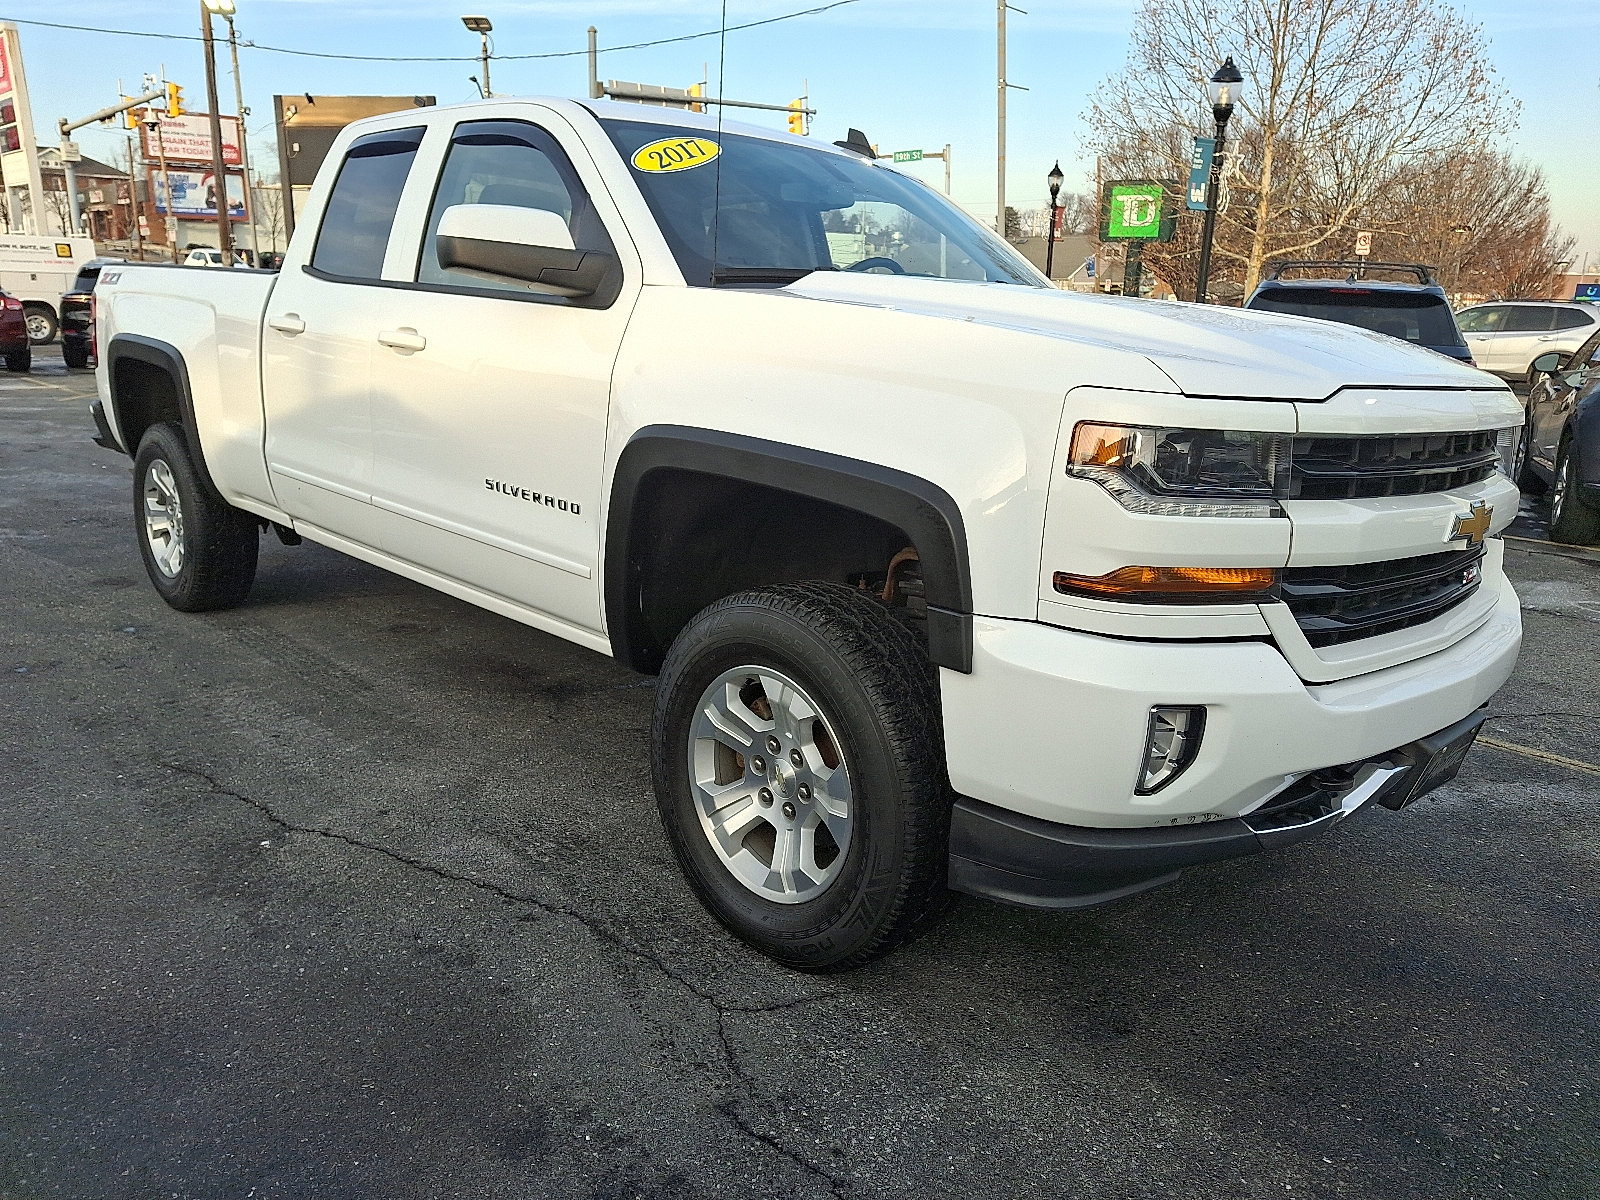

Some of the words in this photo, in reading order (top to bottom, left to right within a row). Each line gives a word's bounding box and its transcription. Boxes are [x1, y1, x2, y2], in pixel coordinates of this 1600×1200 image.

[151, 145, 180, 153] CEAR
[648, 140, 706, 169] 2017
[895, 152, 911, 161] 19th
[912, 151, 921, 160] St
[1116, 194, 1155, 227] TD
[485, 478, 580, 515] SILVERADO
